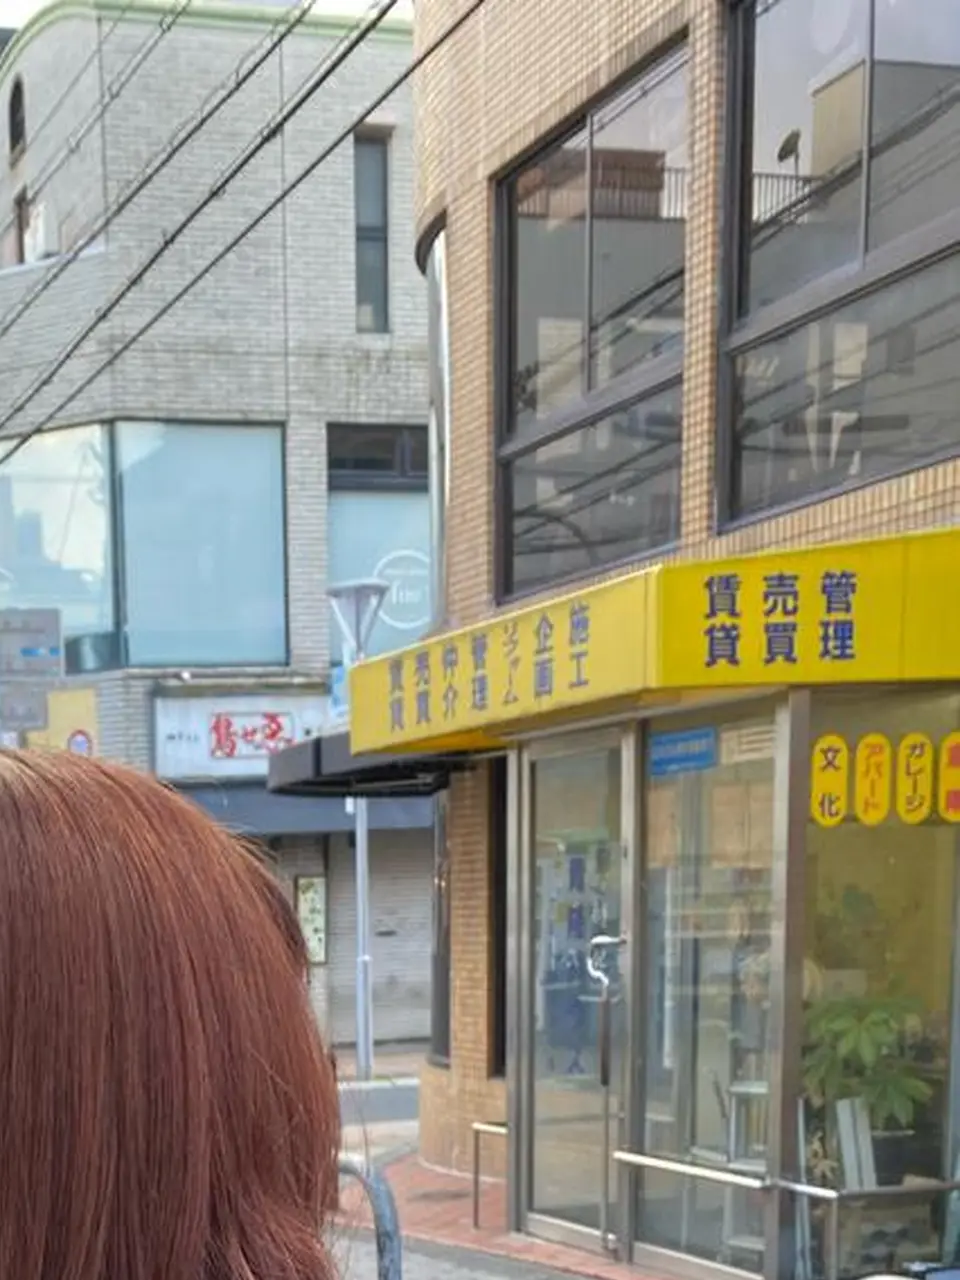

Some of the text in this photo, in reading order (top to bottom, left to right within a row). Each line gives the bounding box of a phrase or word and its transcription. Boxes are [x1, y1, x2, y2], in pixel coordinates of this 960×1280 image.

[533, 612, 555, 699] 企画
[704, 573, 741, 668] 賃貸
[762, 570, 799, 665] 売買
[819, 569, 856, 661] 管理
[818, 746, 842, 818] 文化
[862, 742, 884, 816] アパート
[904, 741, 926, 815] ガレージ
